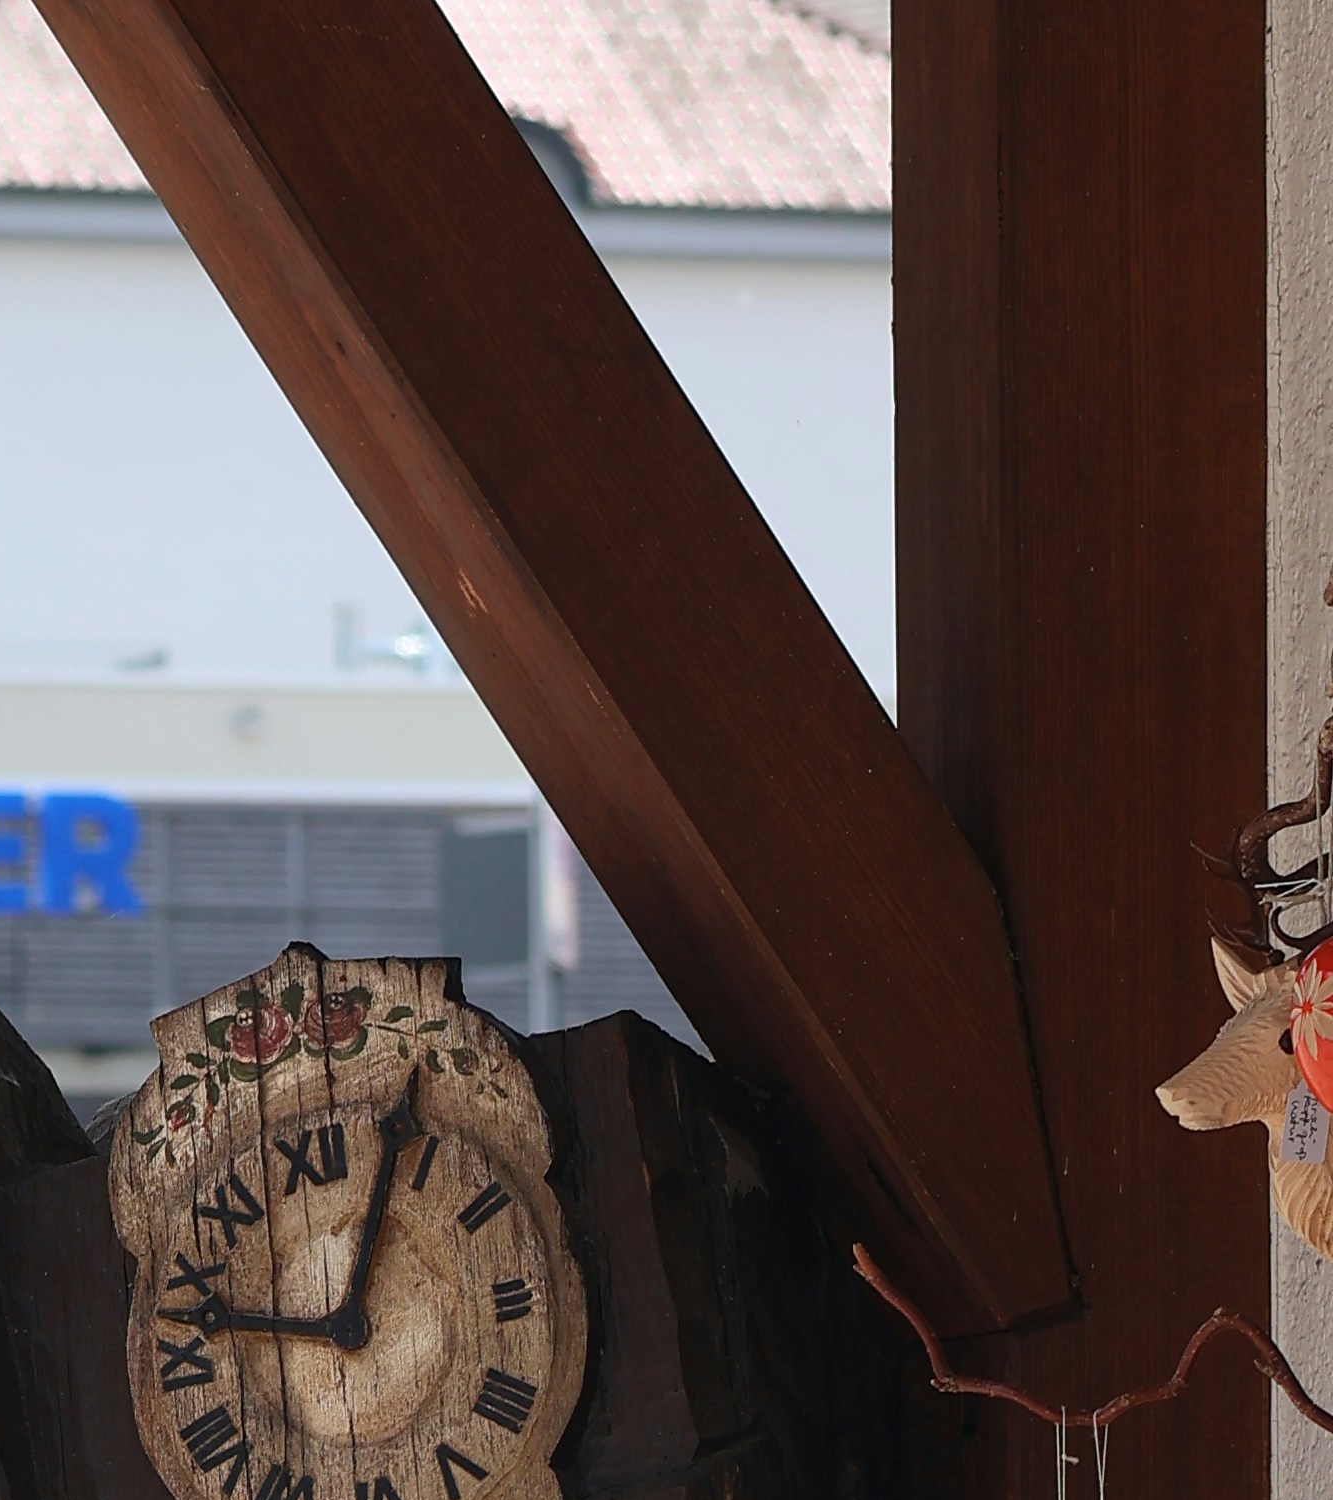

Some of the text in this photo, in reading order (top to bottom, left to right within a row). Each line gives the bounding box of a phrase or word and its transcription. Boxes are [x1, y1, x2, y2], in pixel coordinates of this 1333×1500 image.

[277, 1123, 347, 1195] XII
[412, 1135, 438, 1189] I
[200, 1174, 264, 1249] XI
[458, 1181, 512, 1233] II
[166, 1251, 226, 1296] X
[493, 1278, 532, 1321] III
[157, 1335, 215, 1392] IX
[472, 1368, 538, 1434] IIII
[180, 1405, 247, 1497] VIII
[436, 1443, 489, 1499] V
